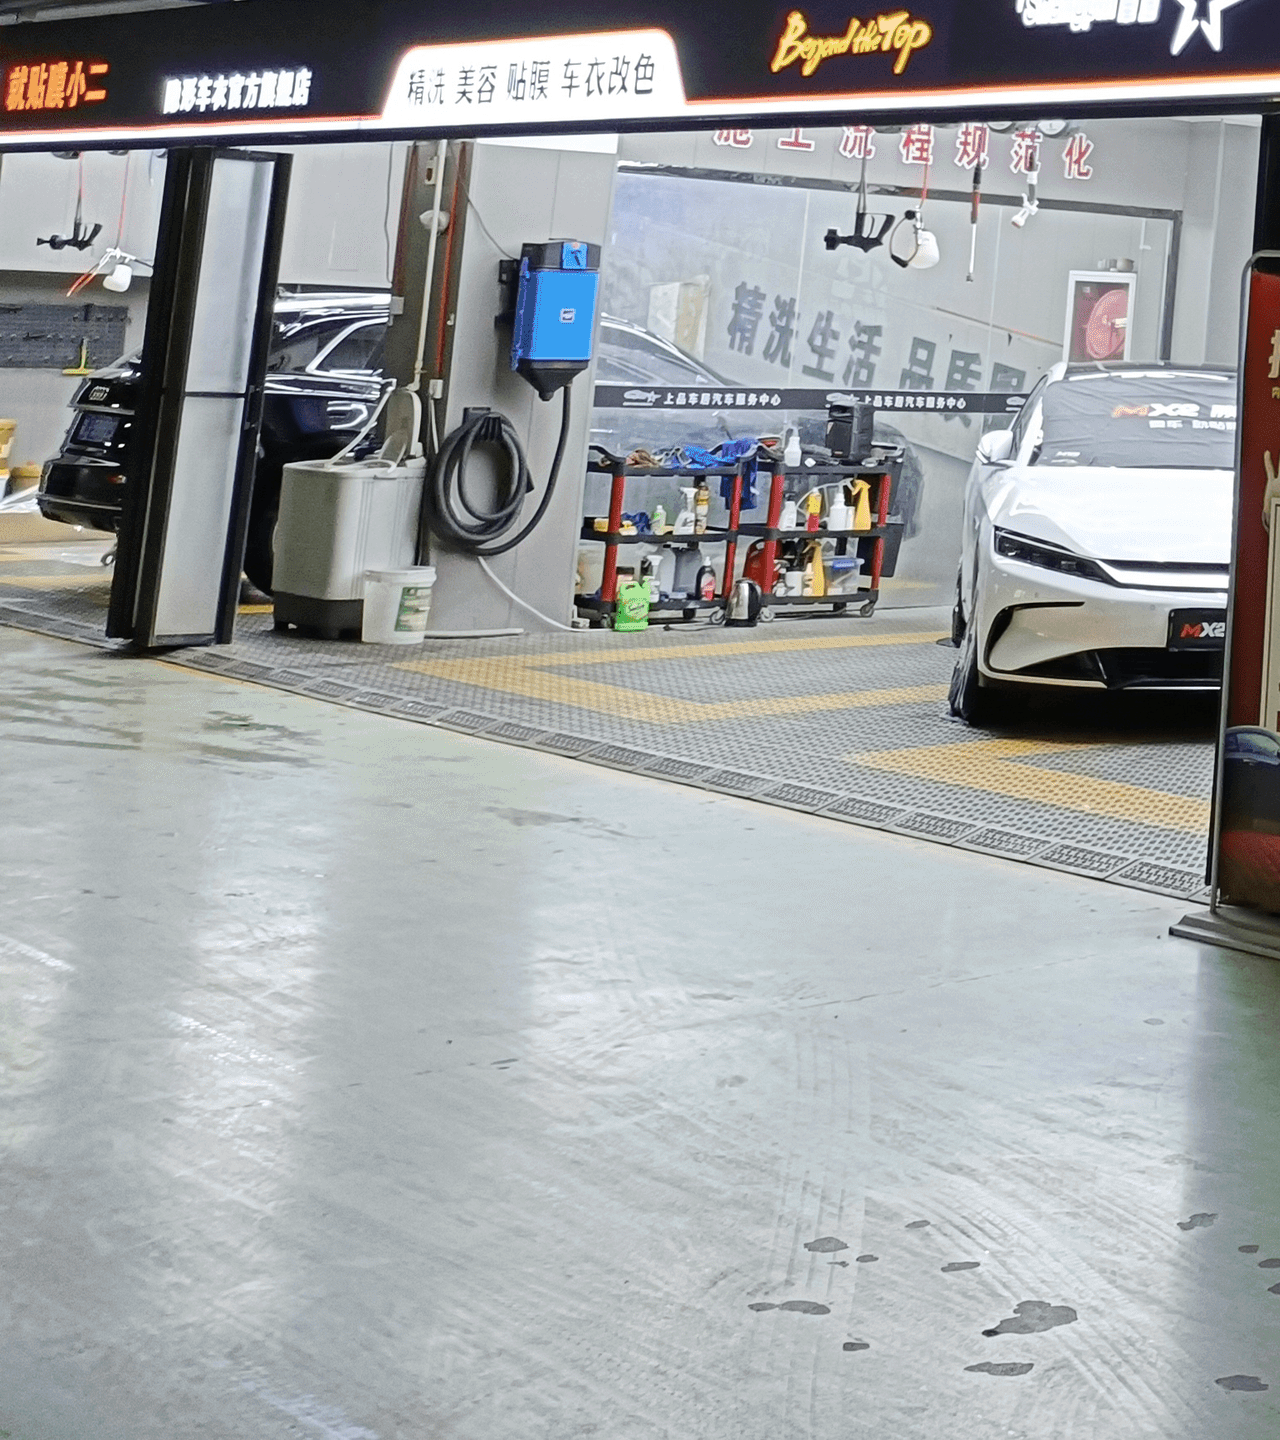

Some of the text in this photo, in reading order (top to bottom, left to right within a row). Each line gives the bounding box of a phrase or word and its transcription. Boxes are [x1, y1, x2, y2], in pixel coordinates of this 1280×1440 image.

[770, 10, 933, 77] Beyond the Top
[6, 61, 109, 111] 就贴膜小二
[162, 65, 313, 115] 隐形车衣官方旗舰店
[407, 52, 656, 106] 精洗 美容 贴膜 车衣改色
[727, 281, 884, 390] 精洗生活
[664, 391, 781, 407] 上品车居汽车服务中心
